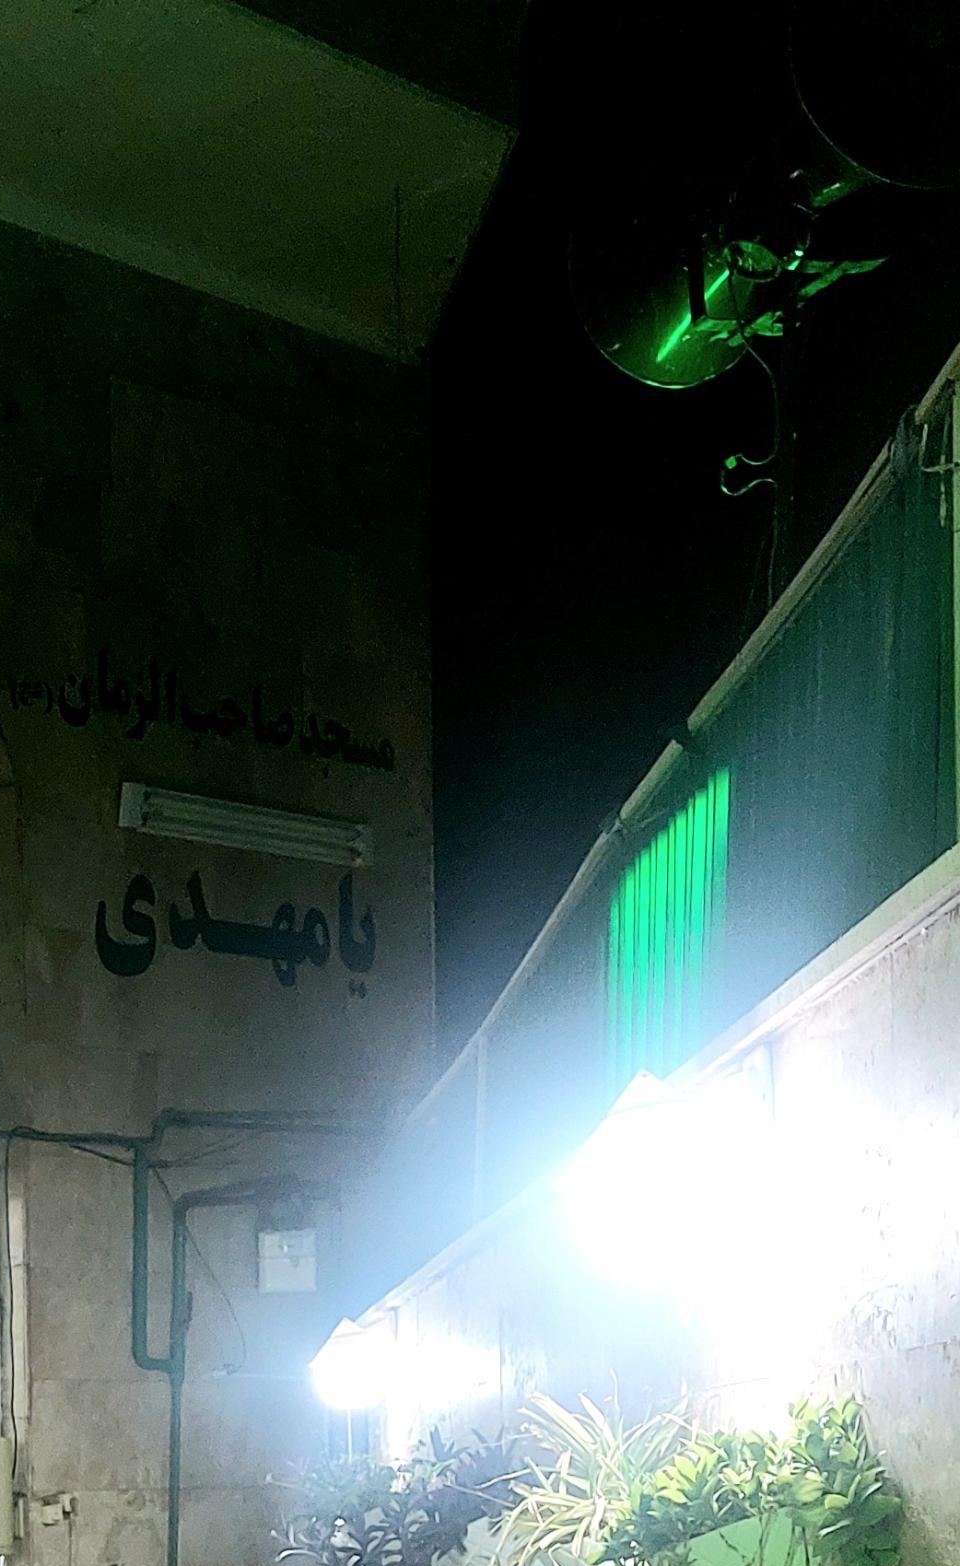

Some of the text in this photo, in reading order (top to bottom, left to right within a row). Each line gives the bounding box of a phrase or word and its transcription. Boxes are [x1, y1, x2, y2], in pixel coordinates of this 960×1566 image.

[59, 647, 177, 740] الزمان
[180, 685, 294, 750] صاحب
[300, 712, 395, 778] مسجد
